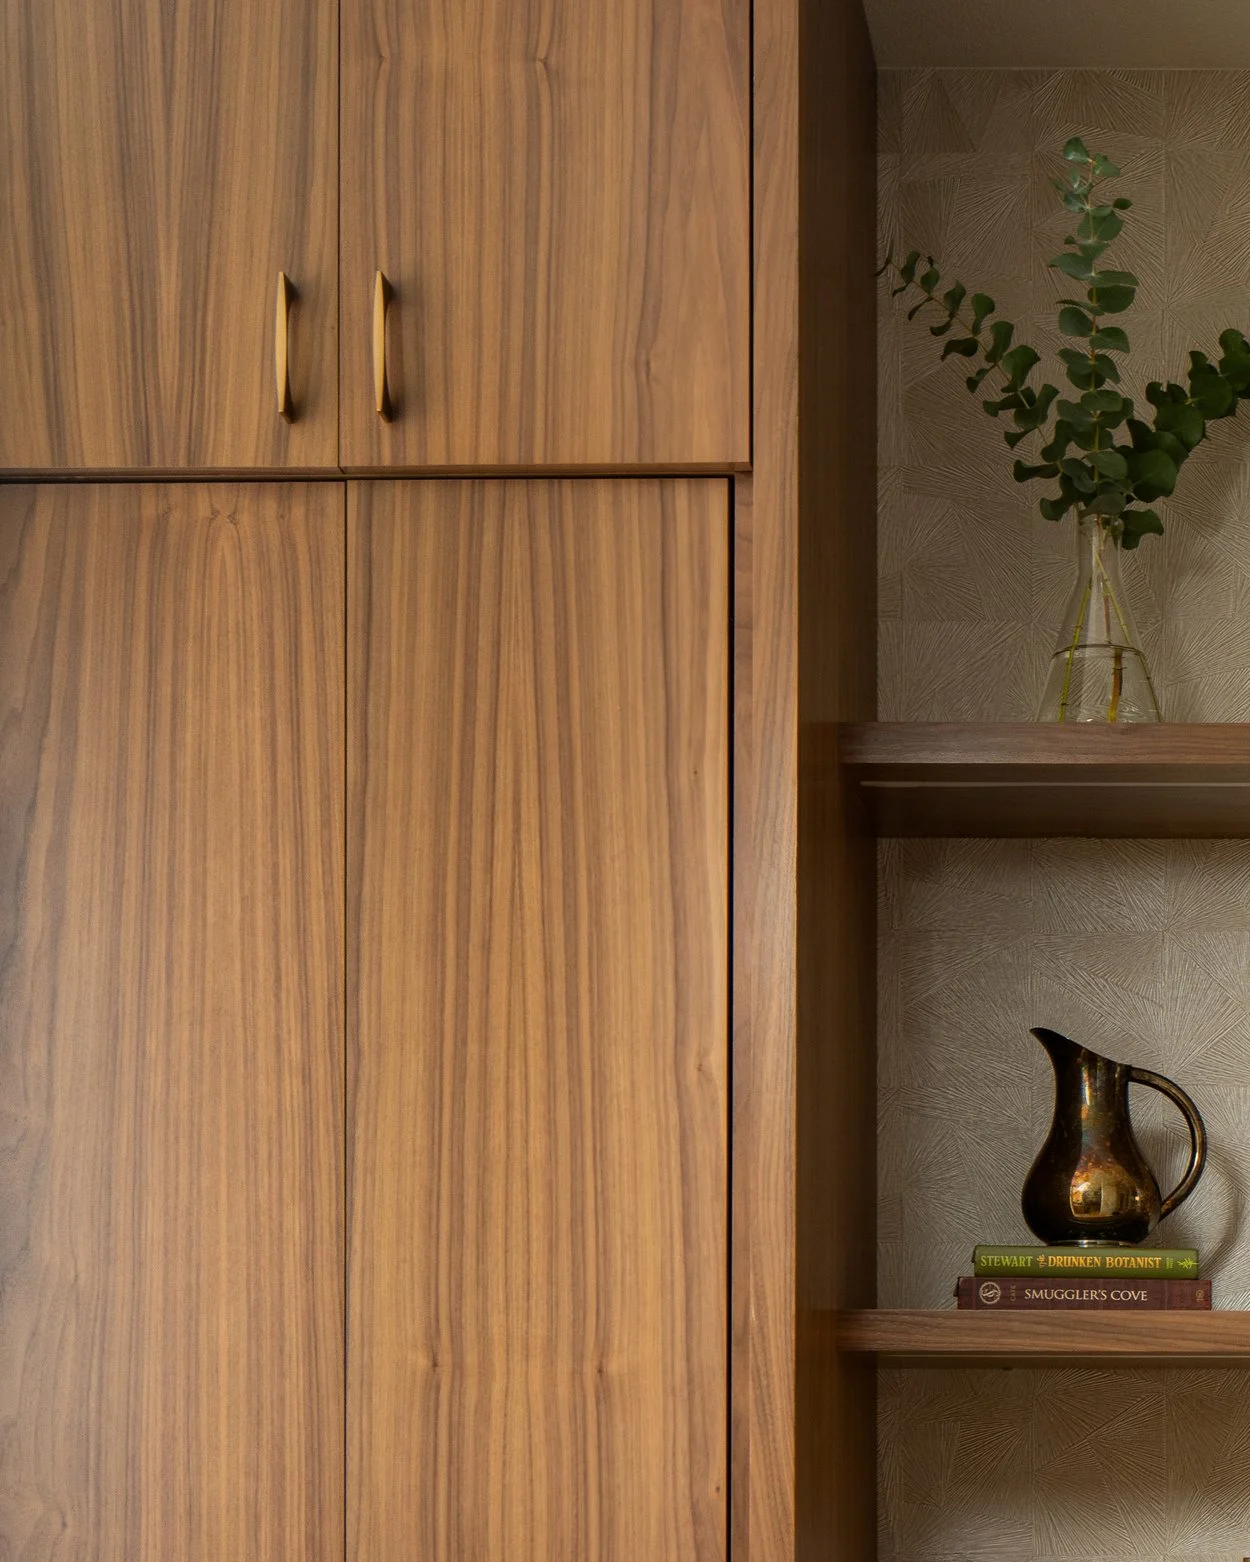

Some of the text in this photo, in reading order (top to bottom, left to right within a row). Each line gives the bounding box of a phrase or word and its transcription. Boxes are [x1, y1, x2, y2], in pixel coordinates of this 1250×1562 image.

[980, 1255, 1033, 1267] STEWART
[1048, 1255, 1102, 1268] DRUNKEN
[1105, 1256, 1162, 1269] BOTANIST
[1024, 1288, 1148, 1301] SMUGGLER'S COVE
